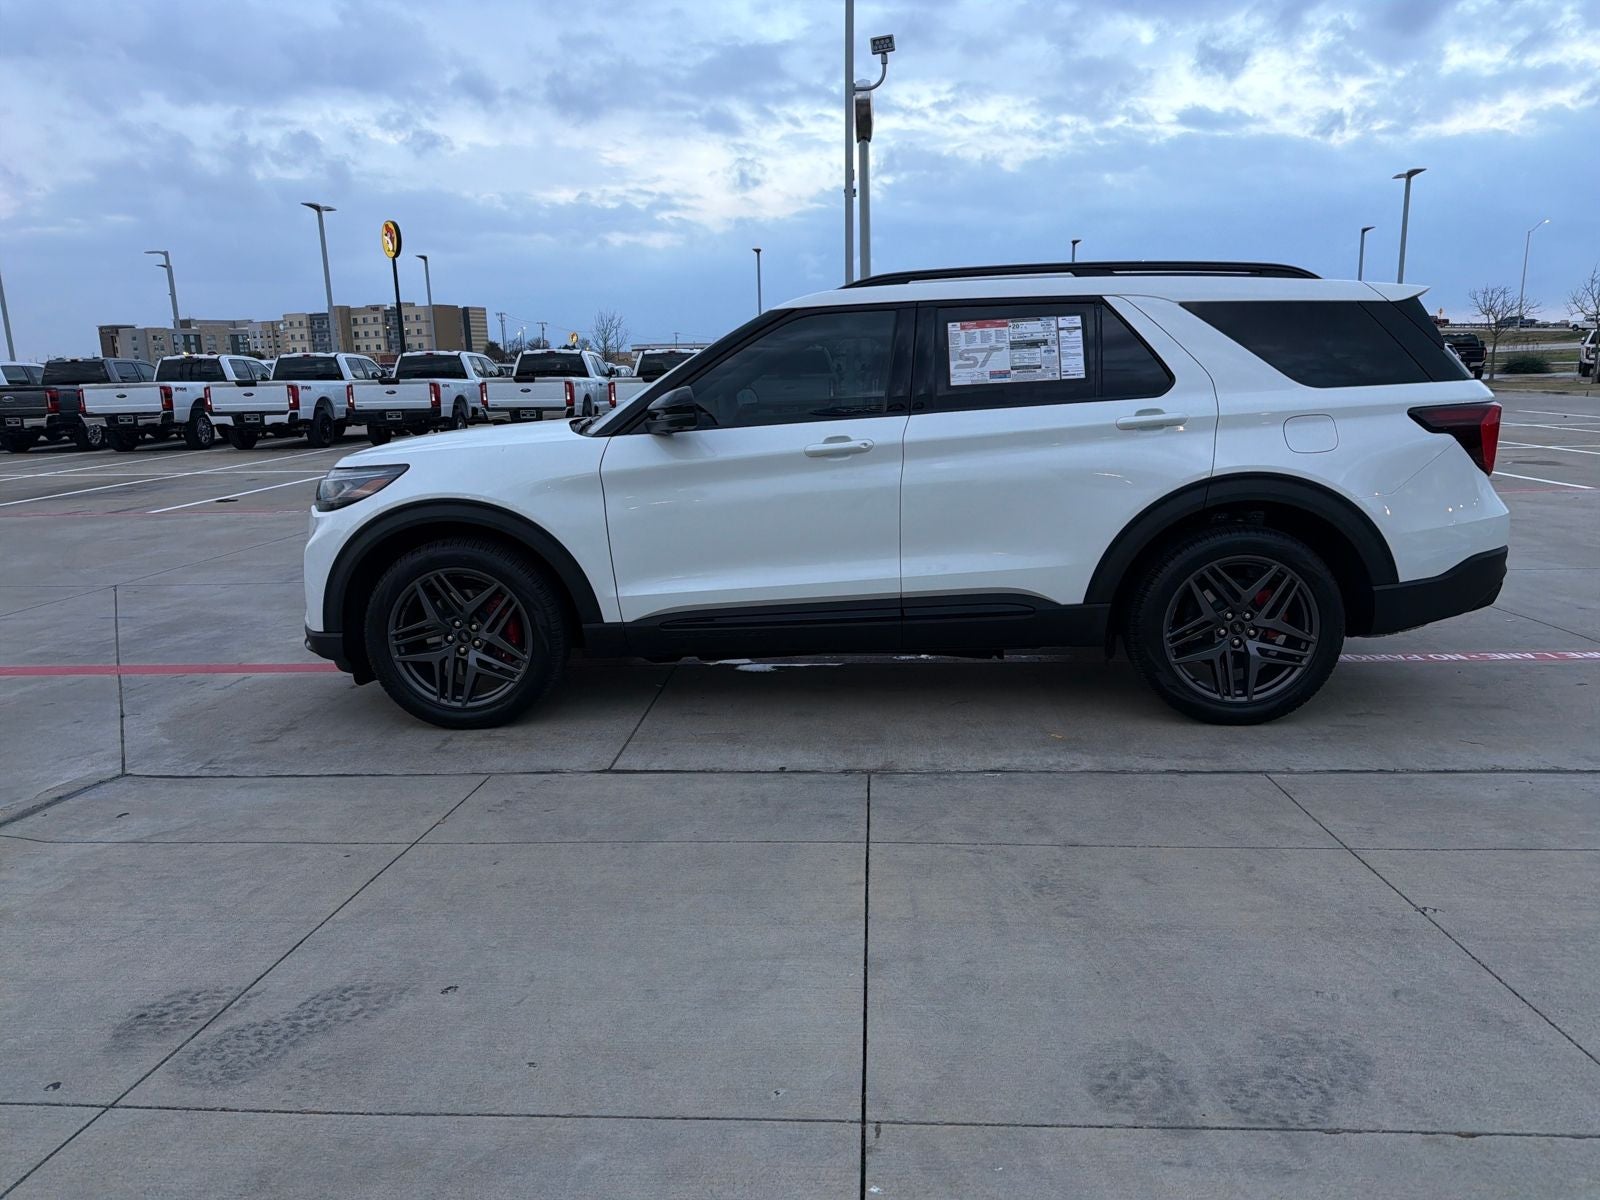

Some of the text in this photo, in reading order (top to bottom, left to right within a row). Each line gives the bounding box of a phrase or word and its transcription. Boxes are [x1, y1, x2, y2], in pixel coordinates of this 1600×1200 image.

[954, 345, 1005, 369] ST
[1428, 653, 1470, 661] NO
[1480, 652, 1558, 660] LANE
